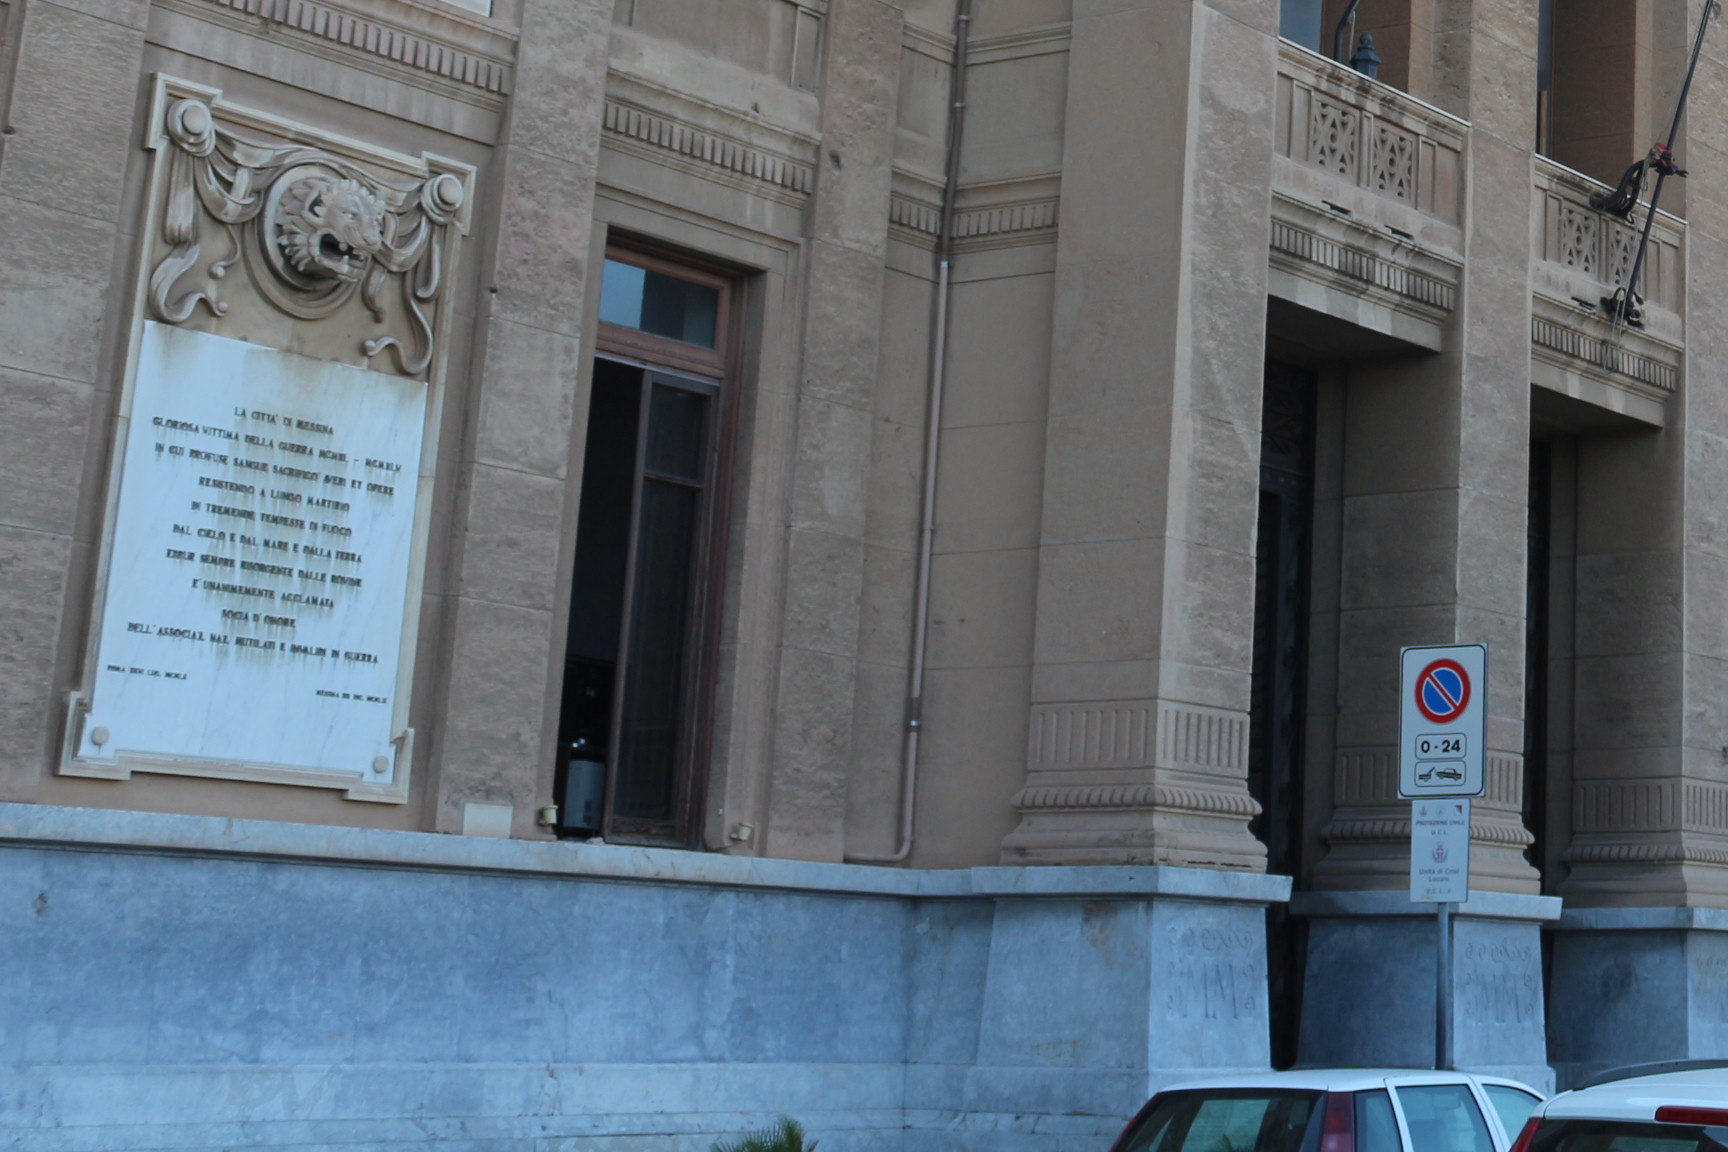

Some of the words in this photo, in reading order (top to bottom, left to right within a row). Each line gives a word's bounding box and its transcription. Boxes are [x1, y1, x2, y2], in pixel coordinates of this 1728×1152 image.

[234, 407, 246, 417] LA
[283, 416, 292, 426] DI
[295, 419, 333, 434] MESSINA
[152, 416, 199, 432] GLORIOSA
[202, 426, 238, 441] VITTIMA
[244, 434, 273, 448] DELLA
[278, 441, 313, 456] GUERRA
[155, 442, 164, 453] IN
[168, 445, 184, 455] CUI
[233, 457, 268, 472] SANGUE
[366, 482, 393, 496] OPERE
[198, 476, 254, 494] RESISTENDO
[260, 488, 265, 497] A
[270, 489, 302, 503] LUNGO
[306, 496, 349, 511] MARTIRIO
[172, 523, 190, 535] DAL
[197, 528, 225, 541] CIELO
[229, 532, 235, 542] E
[239, 534, 256, 546] DAL
[262, 538, 288, 552] MARE
[292, 543, 298, 553] E
[302, 545, 331, 559] DALLA
[335, 550, 361, 562] TERRA
[321, 523, 351, 536] FUOCO
[199, 554, 235, 568] SEMPRE
[297, 569, 326, 582] DALLE
[280, 592, 333, 608] ACCLAMATA
[343, 651, 377, 663] GUERRA
